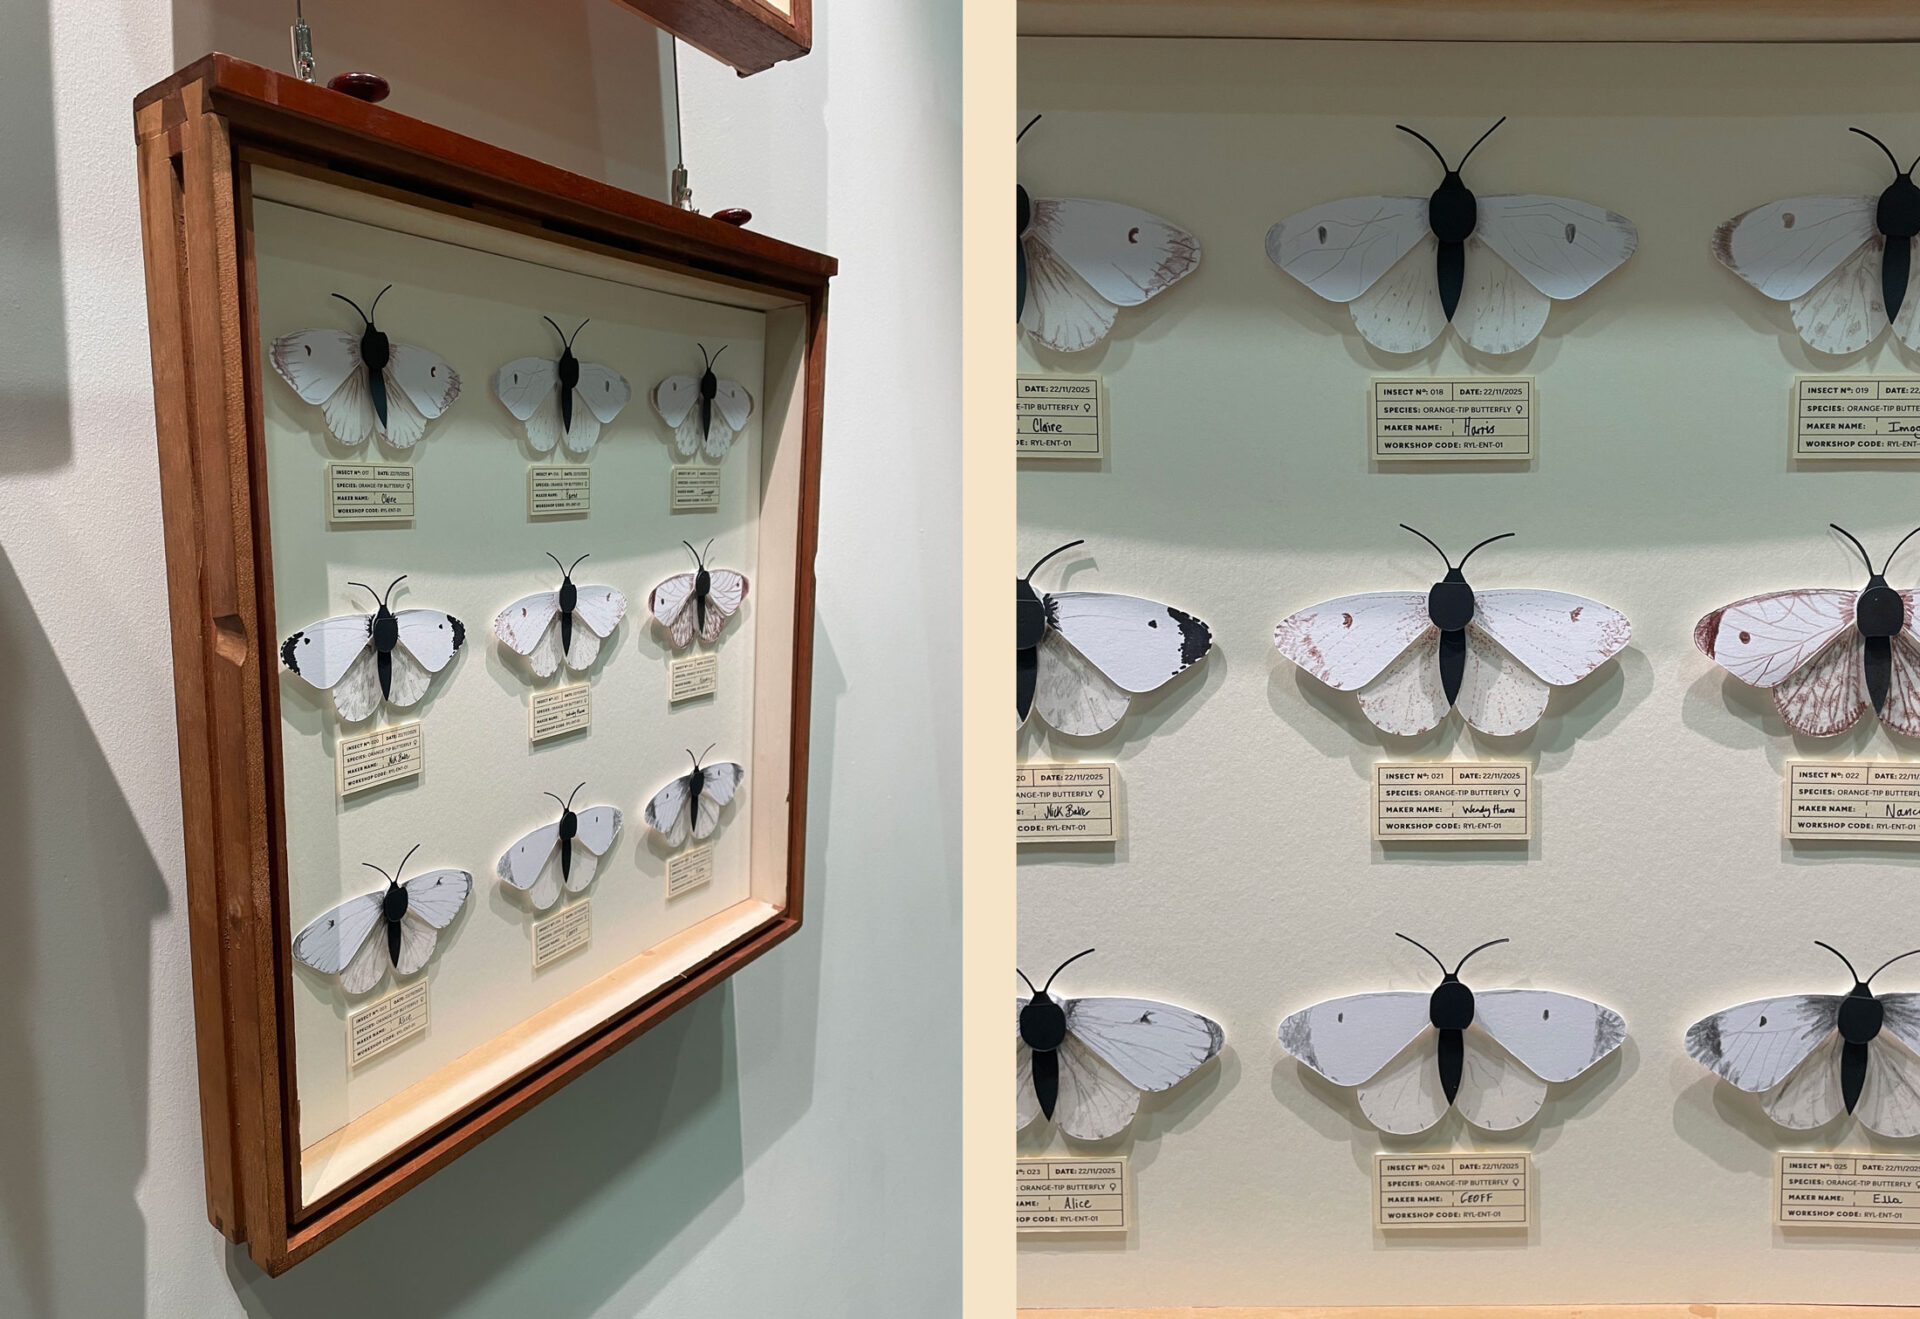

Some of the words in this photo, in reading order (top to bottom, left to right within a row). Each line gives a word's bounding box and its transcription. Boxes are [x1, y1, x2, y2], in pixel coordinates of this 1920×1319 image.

[1033, 418, 1062, 432] Claire
[1064, 1197, 1092, 1210] Alice
[1873, 1193, 1903, 1204] Ella
[1864, 1211, 1902, 1219] RYL-ENT-01
